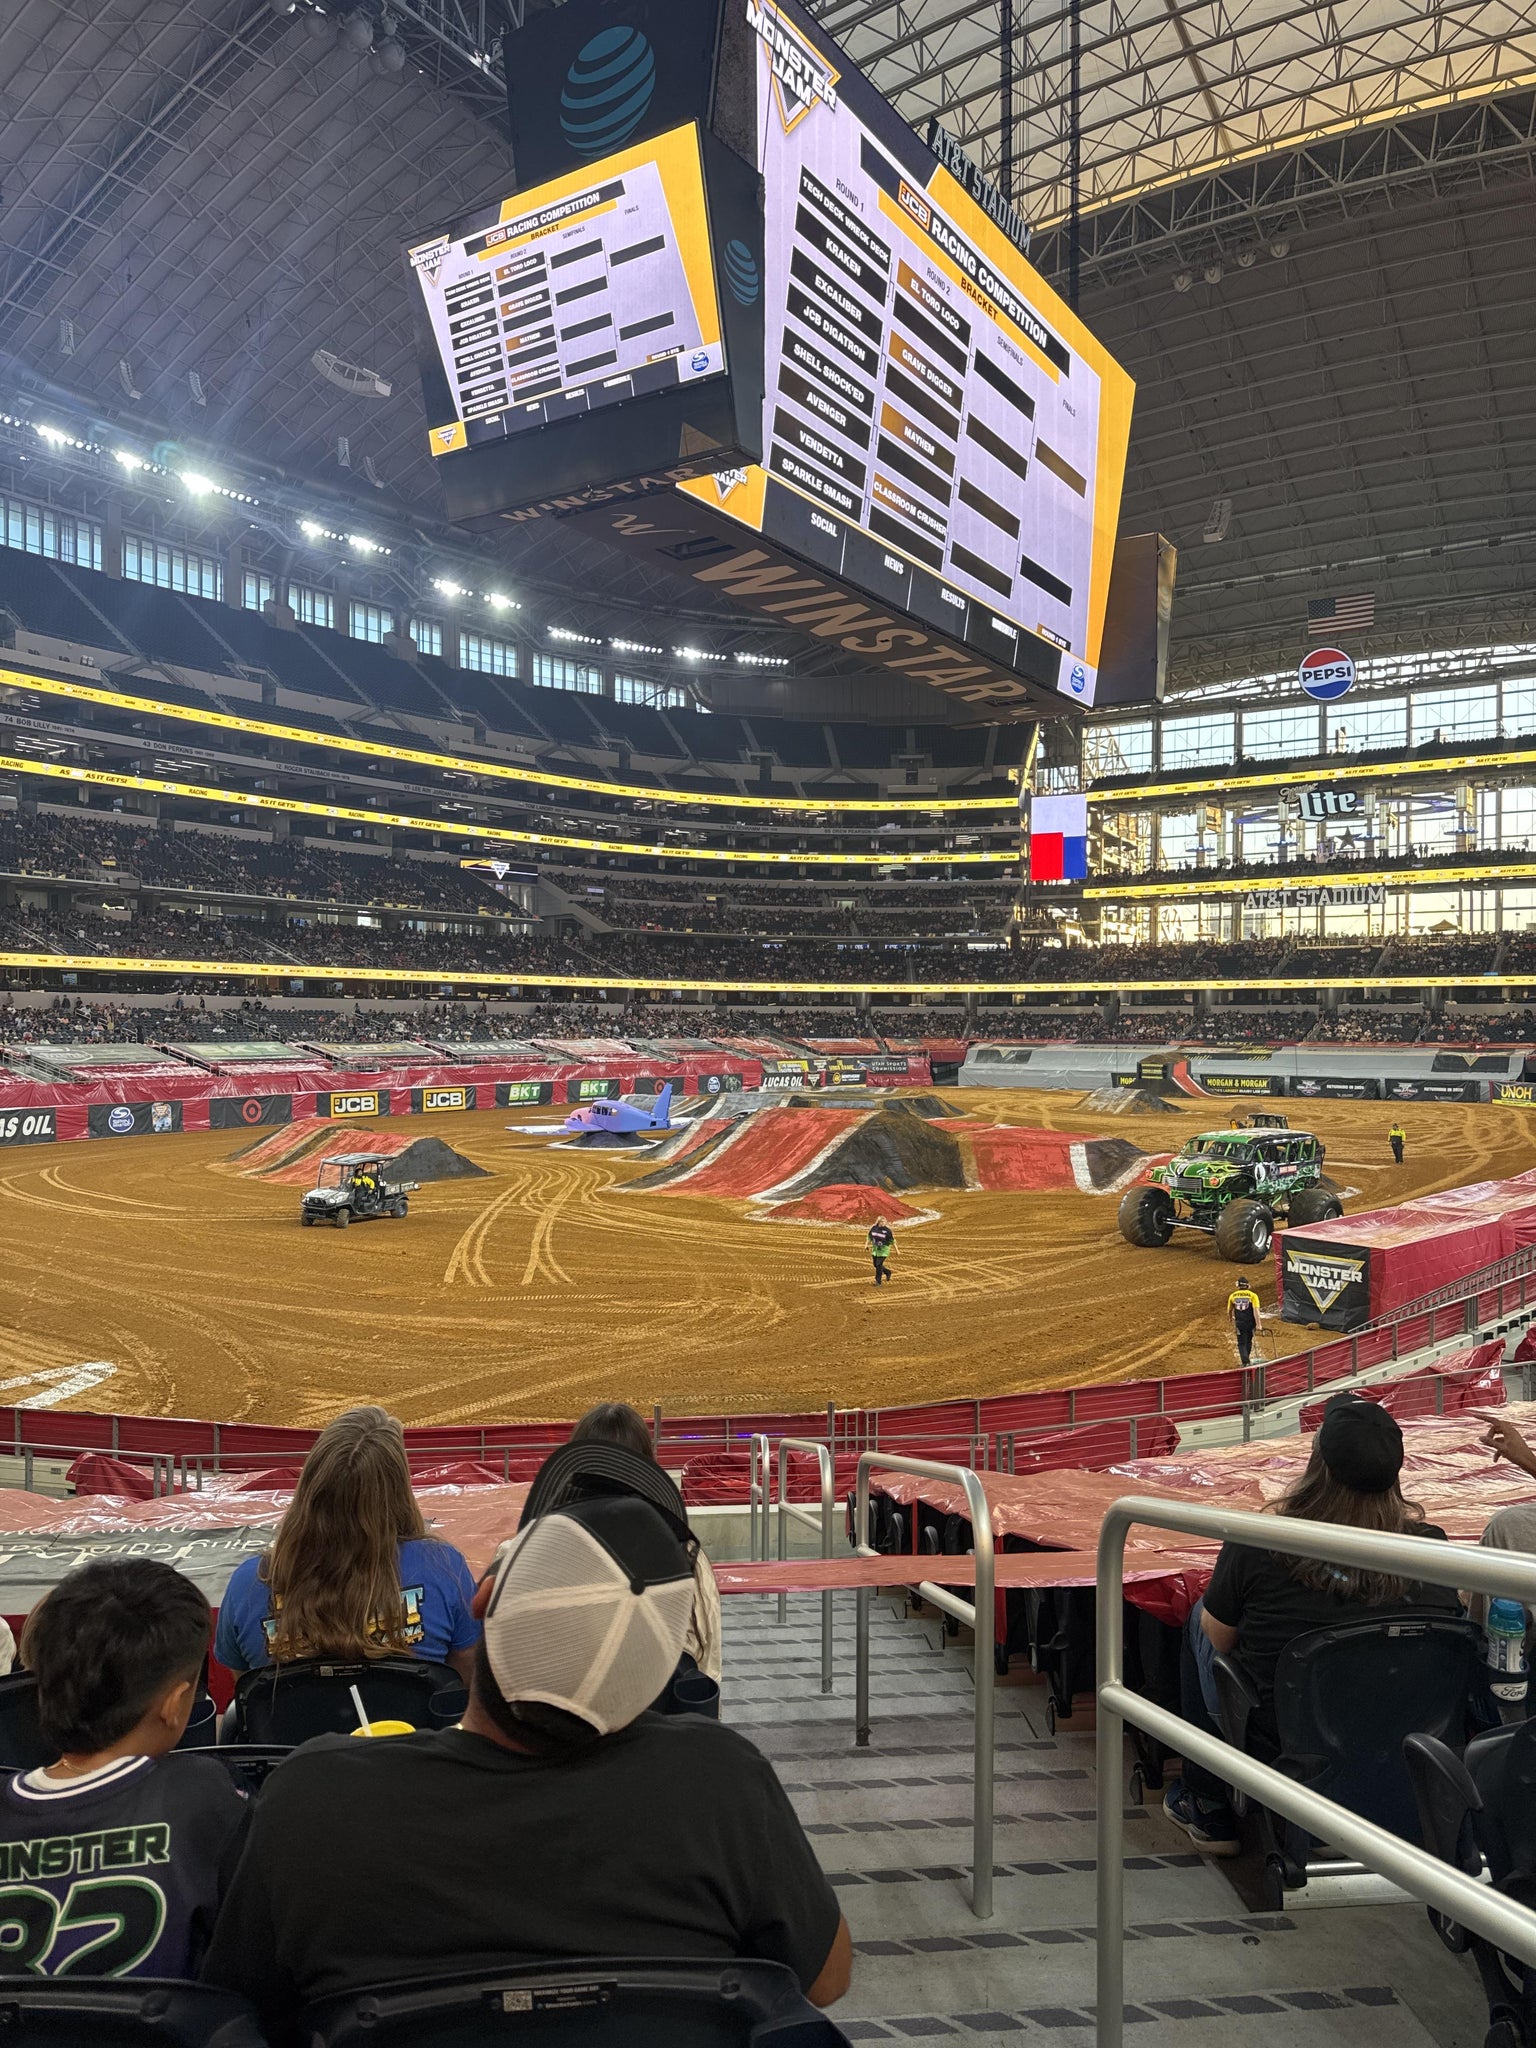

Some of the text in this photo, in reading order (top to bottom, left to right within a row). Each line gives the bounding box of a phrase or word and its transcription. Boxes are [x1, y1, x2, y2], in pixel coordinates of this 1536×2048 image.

[746, 0, 838, 111] MONSTER
[772, 53, 812, 108] JAM
[836, 178, 860, 208] ROUND
[932, 123, 1032, 257] AT&T STADIUM
[487, 191, 600, 244] JCB RACING COMPETITION
[802, 176, 889, 264] TECH DECK WRECK DECK
[530, 223, 560, 240] BRACKET
[410, 244, 451, 267] MONSTER
[422, 257, 443, 272] JAM
[523, 258, 538, 269] LOCO
[825, 237, 862, 277] KRAKEN
[901, 192, 1048, 349] JCB RACING COMPETITION
[926, 267, 946, 291] ROUND
[814, 274, 863, 322] EXCALIBER
[910, 278, 960, 330] EL TORO LOCO
[961, 276, 999, 321] BRACKET
[803, 305, 866, 362] JCB DIGATRON
[997, 335, 1024, 367] SEMIFINALS
[793, 343, 865, 403] SHELL SHOCK'ED
[902, 348, 954, 398] GRAVE DIGGER
[806, 391, 847, 427] AVENGER
[1063, 399, 1076, 418] FINALS
[799, 430, 844, 469] VENDETTA
[904, 425, 936, 456] MAYHEM
[500, 467, 701, 522] WINSTAR
[782, 458, 823, 492] SPARKLE
[823, 483, 853, 510] SMASH
[873, 481, 949, 537] CLASSROOM CRUSHER
[810, 512, 839, 538] SOCIAL
[884, 554, 905, 576] NEWS
[692, 549, 1028, 703] WINSTAR
[1302, 666, 1352, 683] PEPSI
[16, 718, 32, 727] BOB
[33, 720, 51, 730] LILLY
[153, 742, 167, 750] DON
[168, 745, 194, 755] PERKINS
[1, 759, 24, 769] RACING
[284, 765, 303, 773] ROGER
[303, 767, 331, 777] STAUBACH
[188, 788, 208, 796] RACING
[1298, 790, 1358, 822] Lite
[1244, 886, 1387, 910] AT&T STADIUM
[510, 1086, 541, 1098] BKT
[581, 1083, 609, 1094] BKT
[762, 1076, 804, 1087] LUCAS OIL
[1207, 1078, 1270, 1088] MORGAN & MORGAN
[1501, 1084, 1534, 1100] UNOH
[334, 1096, 375, 1113] JCB
[427, 1092, 463, 1107] JCB
[22, 1114, 55, 1136] OIL.
[1286, 1261, 1363, 1283] MONSTER
[1307, 1276, 1342, 1291] JAM
[1501, 1685, 1526, 1698] Ford
[0, 1822, 171, 1883] NSTER
